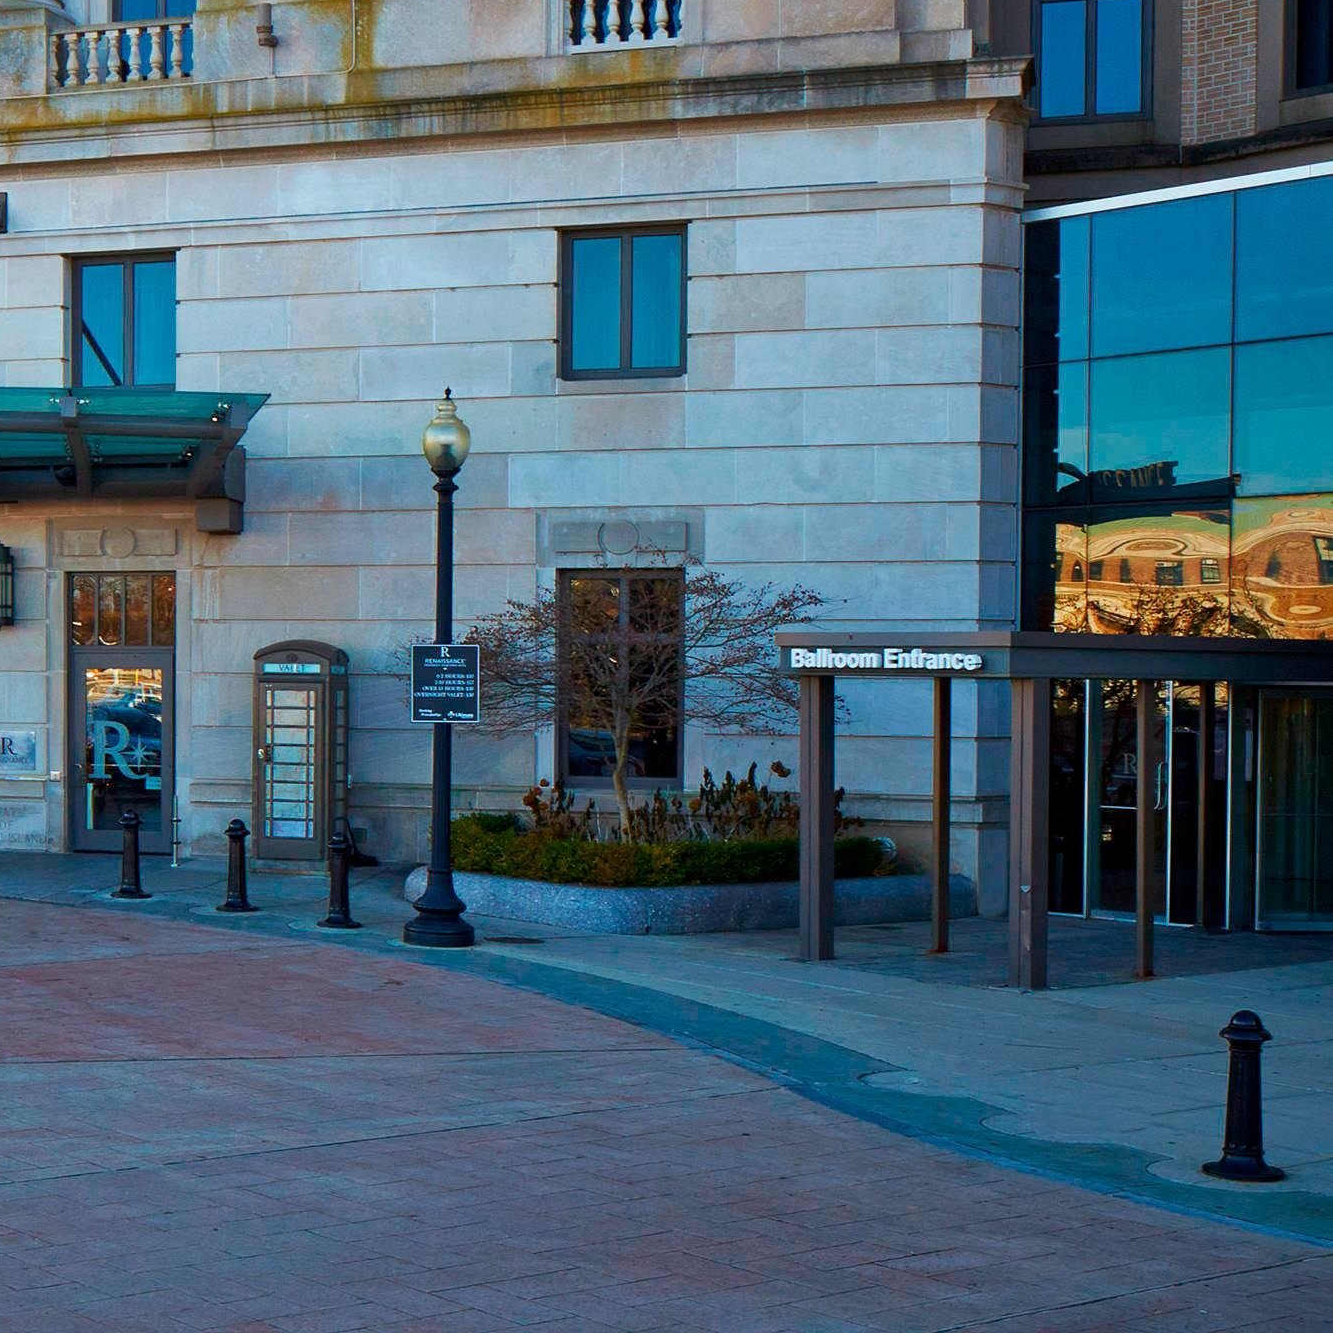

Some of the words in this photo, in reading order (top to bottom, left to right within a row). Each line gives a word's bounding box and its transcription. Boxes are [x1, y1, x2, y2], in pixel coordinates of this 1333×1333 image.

[440, 646, 451, 657] R
[790, 648, 882, 669] Ballroom
[883, 648, 983, 671] Entrance
[278, 664, 306, 672] VALET
[0, 737, 18, 755] R
[88, 720, 150, 780] R
